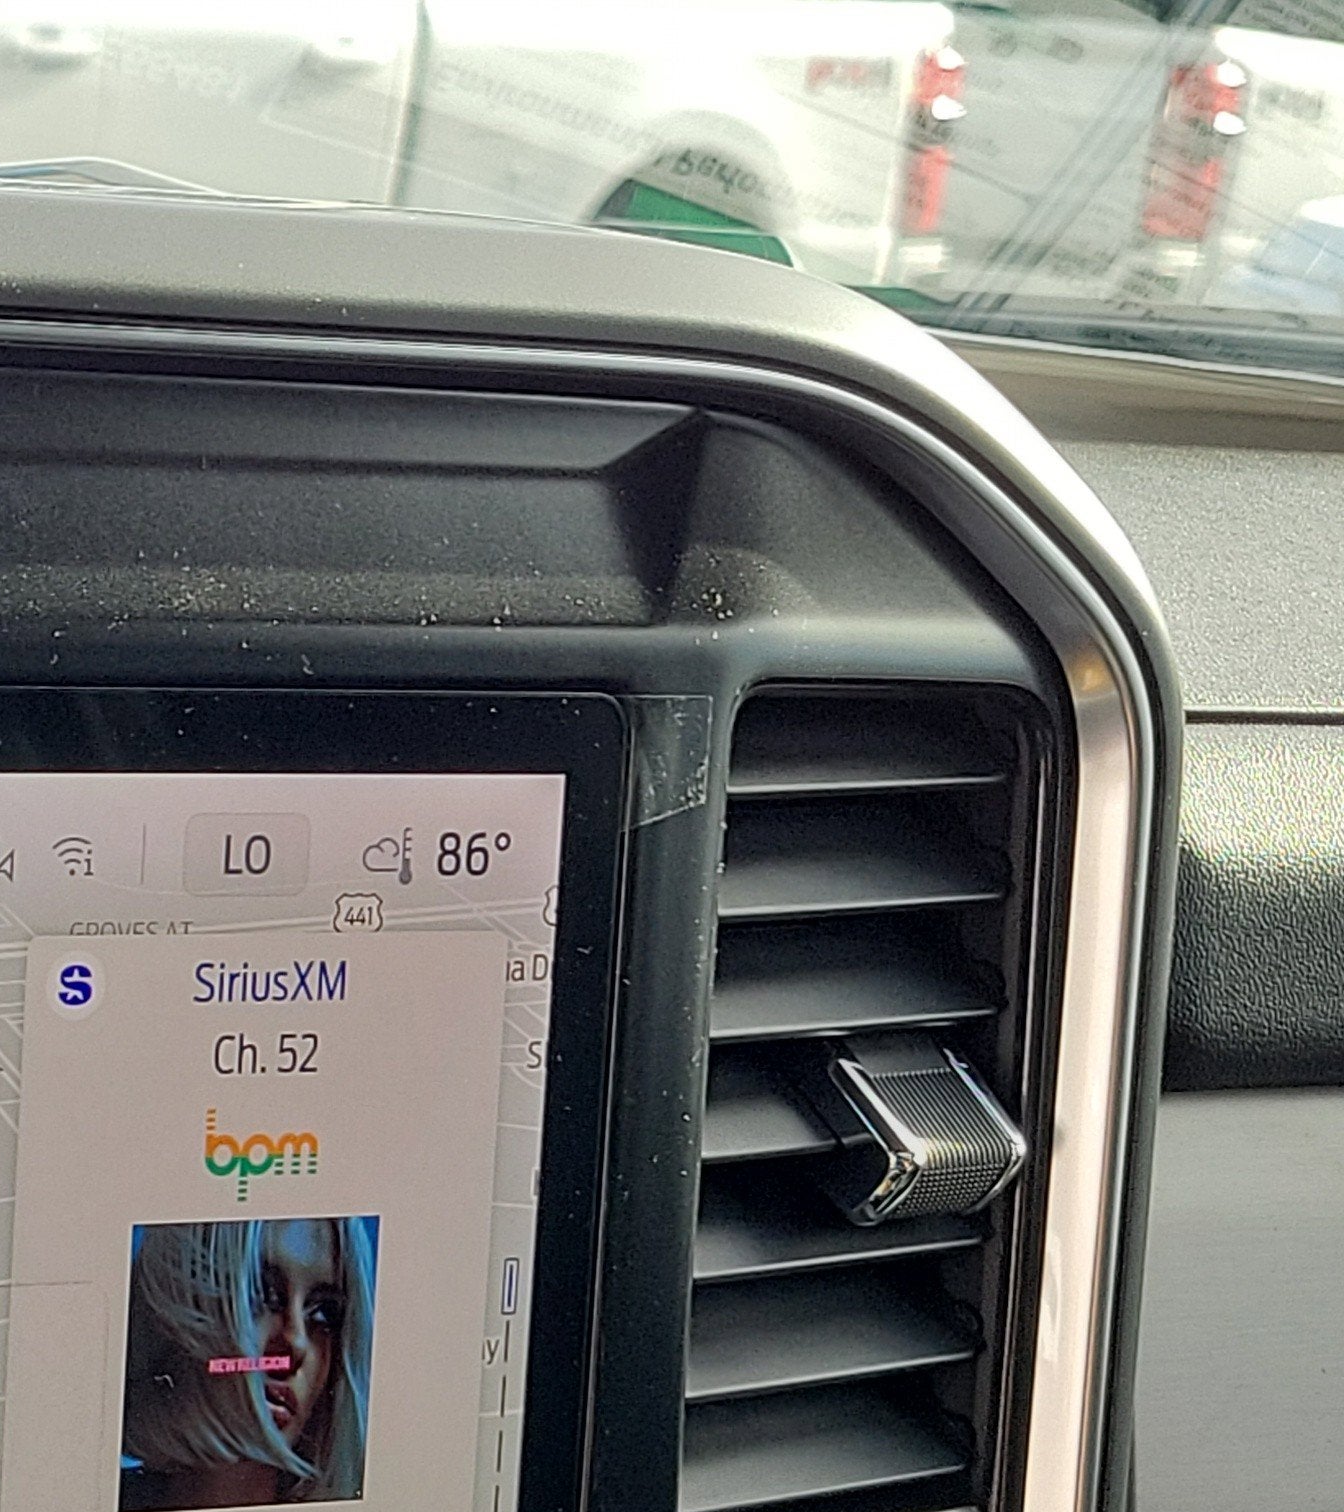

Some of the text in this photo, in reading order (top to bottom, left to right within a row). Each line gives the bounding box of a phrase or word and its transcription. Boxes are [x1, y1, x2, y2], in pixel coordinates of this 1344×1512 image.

[224, 834, 271, 875] LO
[436, 832, 512, 877] 86°
[344, 906, 374, 926] 441
[193, 960, 348, 1004] SiriusXM
[214, 1033, 320, 1076] Ch. 52
[205, 1107, 318, 1203] bpm
